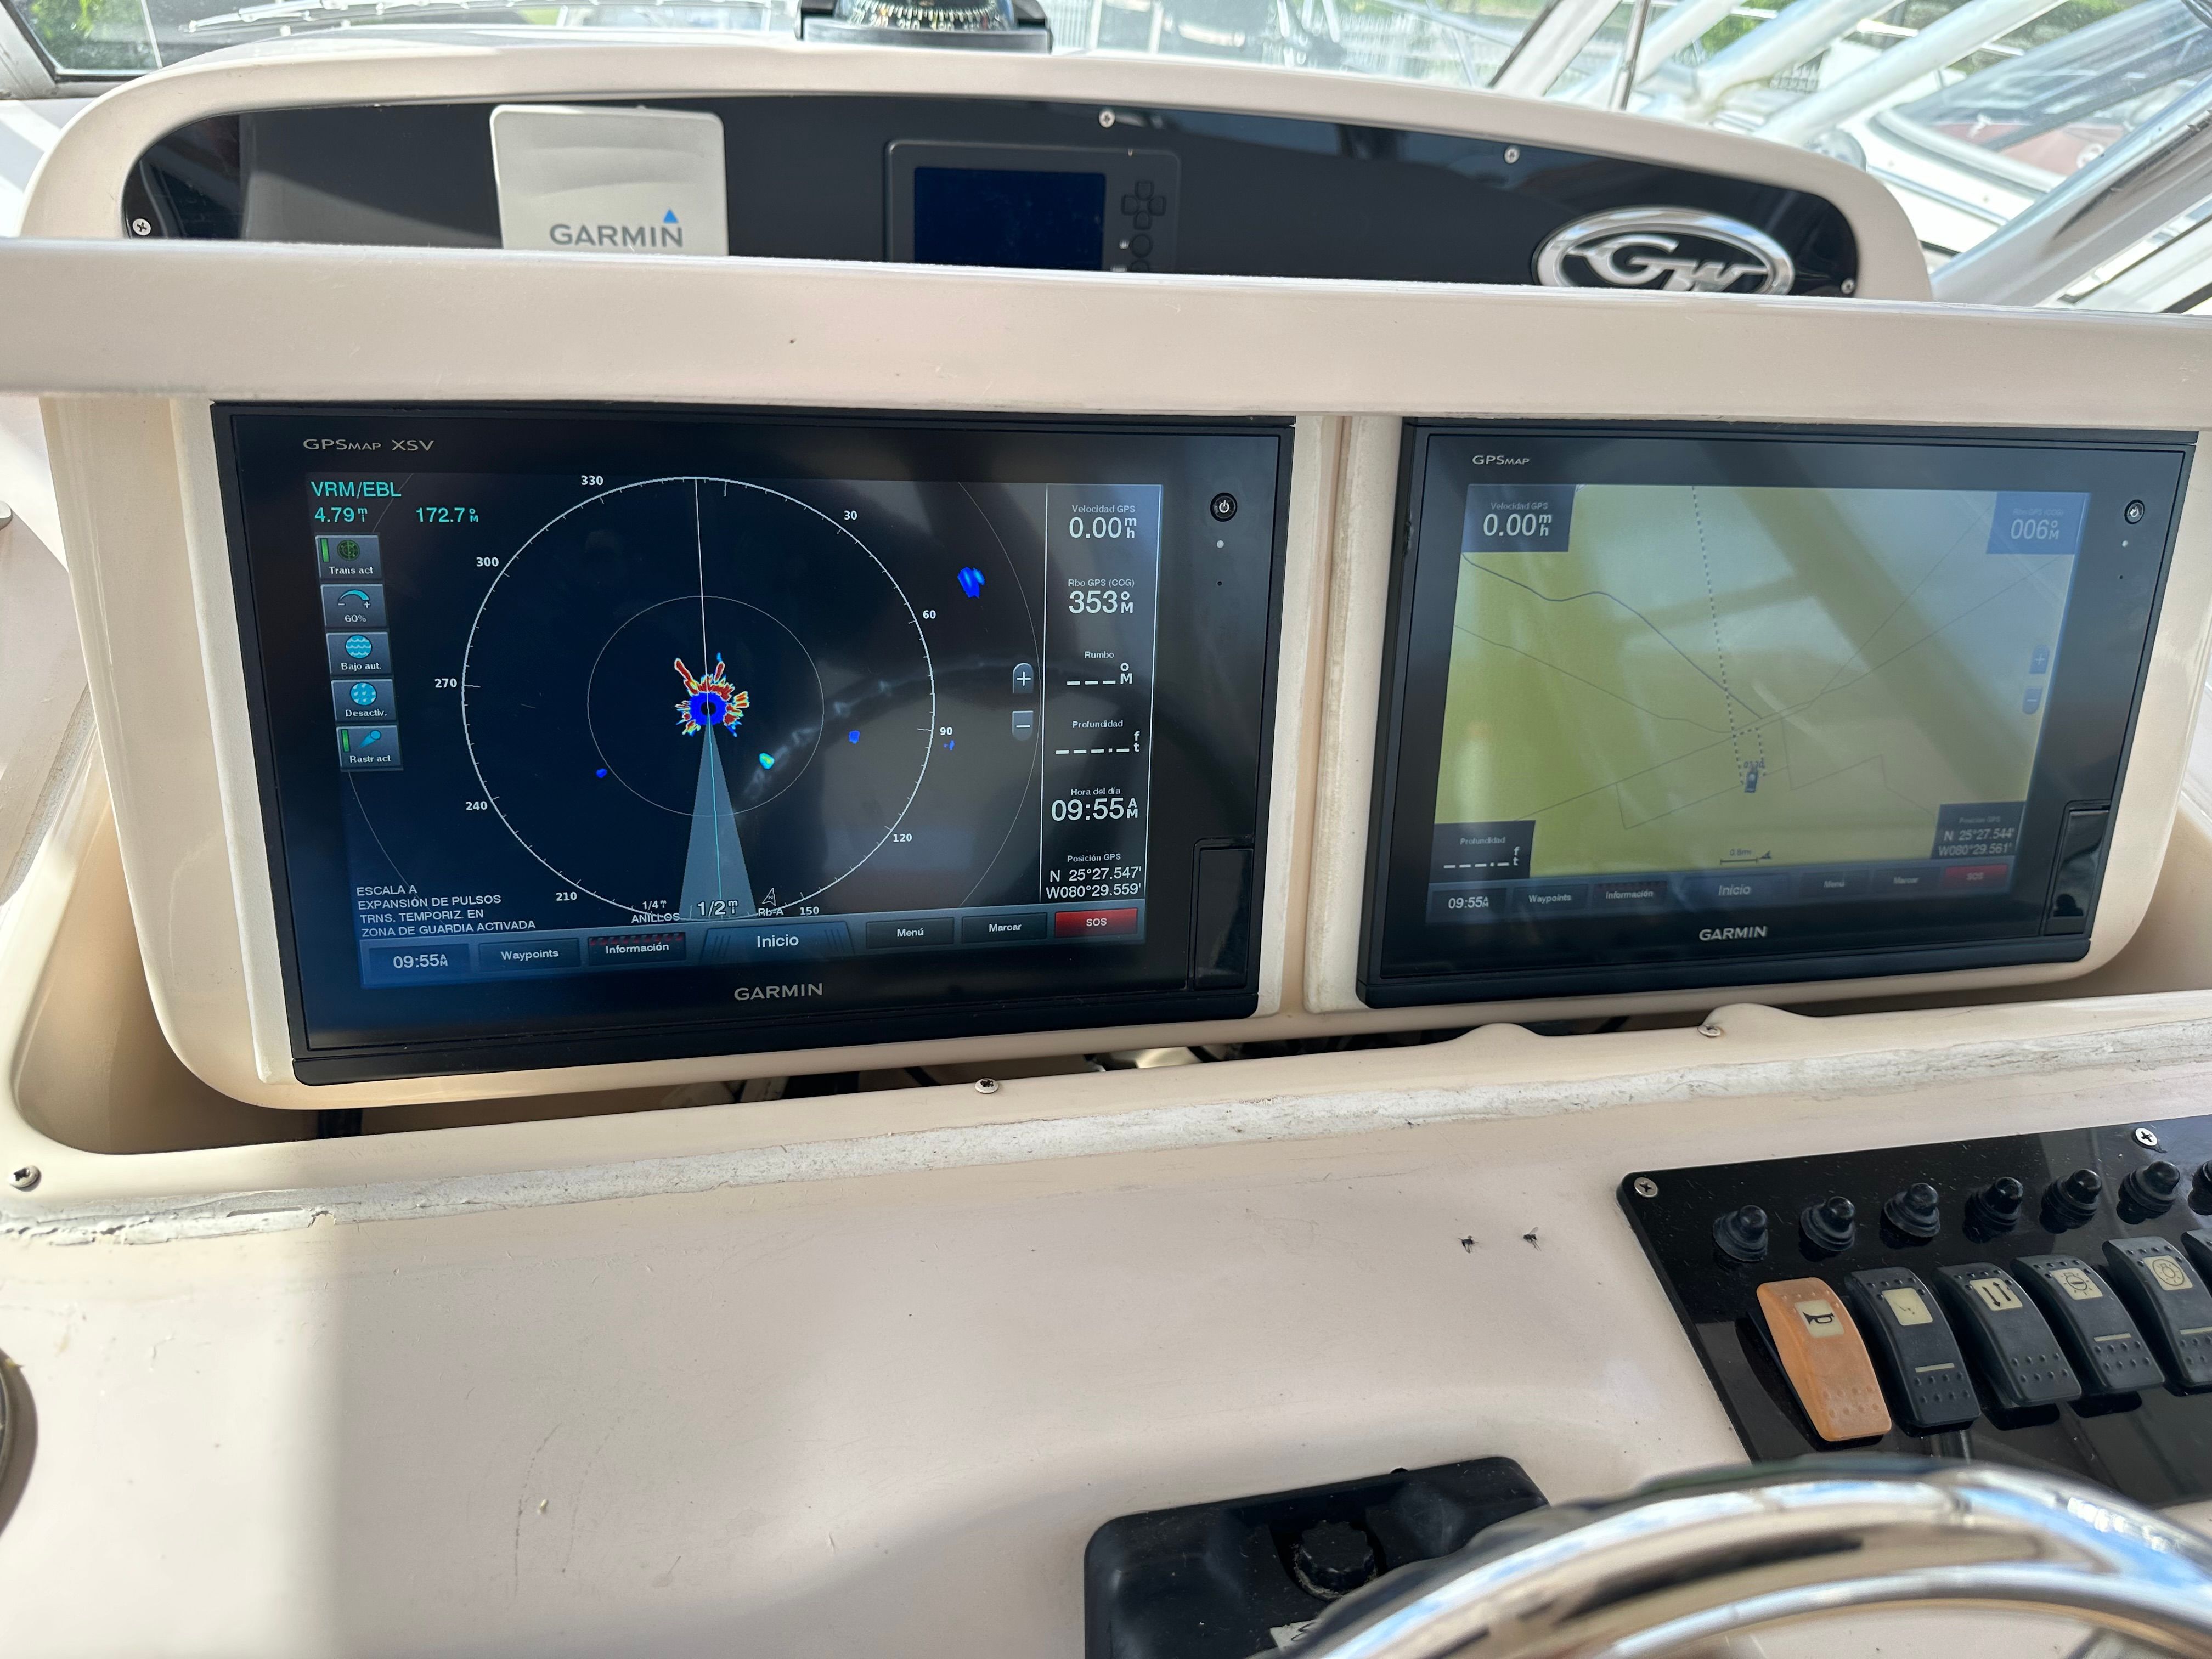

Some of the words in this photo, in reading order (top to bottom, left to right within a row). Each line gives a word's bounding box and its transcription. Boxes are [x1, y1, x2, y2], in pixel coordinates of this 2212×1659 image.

[550, 224, 684, 247] GARMIN
[303, 439, 381, 451] GPSMAP
[392, 439, 435, 452] XSV
[1472, 455, 1530, 466] GPSMAP
[580, 475, 603, 486] 330
[311, 481, 402, 499] VRM/EBL
[1071, 504, 1115, 514] Velocidad
[1116, 505, 1136, 514] GPS
[1490, 501, 1530, 511] Velocidad
[1531, 502, 1549, 510] GPS
[314, 507, 356, 523] 4.79
[416, 507, 465, 523] 172.7
[844, 510, 857, 521] 30
[476, 557, 499, 567] 300
[328, 566, 356, 575] Trans
[357, 566, 374, 575] act
[1068, 579, 1086, 587] Rbo
[1087, 579, 1107, 587] GPS
[1108, 579, 1135, 588] (COG)
[344, 614, 367, 623] 60%
[922, 609, 937, 620] 60
[1084, 651, 1115, 659] Rumbo
[341, 662, 363, 673] Bajo
[434, 678, 458, 689] 270
[345, 708, 387, 718] Desactiv.
[1072, 720, 1124, 729] Profundidad
[939, 727, 953, 736] 90
[349, 755, 375, 764] Rastr
[376, 754, 391, 763] act
[465, 801, 488, 811] 240
[893, 833, 913, 843] 120
[1459, 837, 1506, 845] Profundidad
[1066, 854, 1102, 862] Posición
[356, 885, 406, 896] ESCALA
[408, 884, 418, 894] A
[1605, 889, 1654, 900] Información
[1718, 884, 1752, 896] Inicio
[555, 891, 578, 901] 210
[1528, 894, 1572, 904] Waypoints
[358, 896, 429, 910] EXPANSIÓN
[431, 896, 449, 907] DE
[452, 895, 502, 906] PULSOS
[697, 900, 726, 917] 1/2
[799, 906, 820, 916] 150
[360, 912, 396, 924] TRNS.
[398, 910, 465, 922] TEMPORIZ.
[467, 909, 484, 919] EN
[631, 912, 681, 924] ANILLOS
[1086, 917, 1108, 927] SOS
[362, 926, 396, 938] ZONA
[398, 926, 416, 936] DE
[419, 923, 474, 935] GUARDIA
[477, 920, 536, 932] ACTIVADA
[896, 927, 924, 938] Menú
[989, 922, 1022, 932] Marcar
[1699, 926, 1768, 941] GARMIN
[757, 934, 799, 949] Inicio
[605, 942, 669, 955] Información
[500, 949, 560, 962] Waypoints
[392, 954, 439, 969] 09:55
[734, 983, 823, 1001] GARMIN
